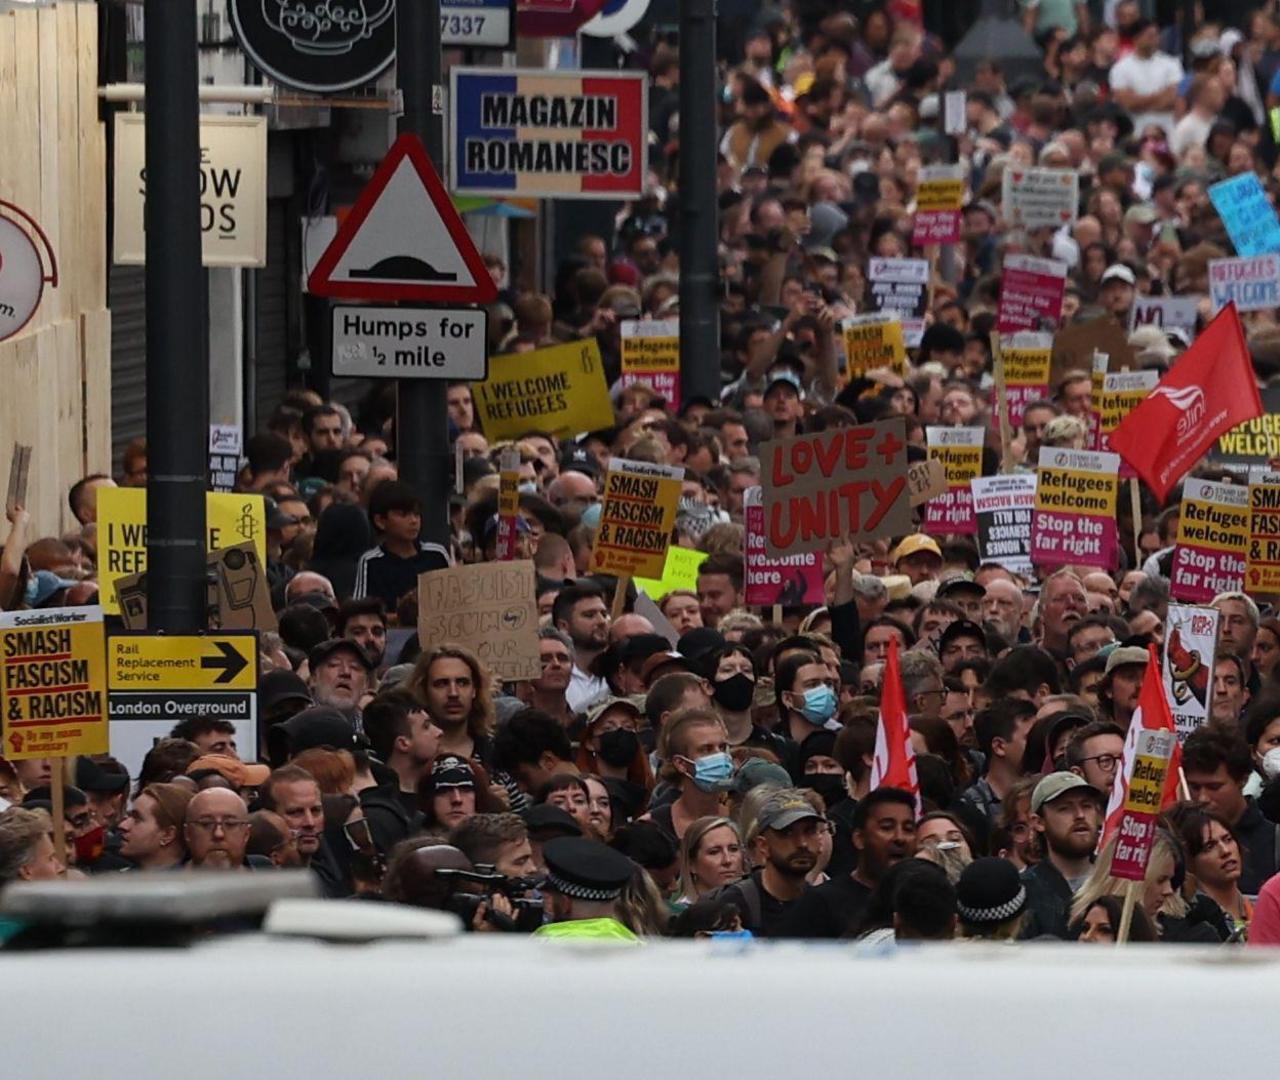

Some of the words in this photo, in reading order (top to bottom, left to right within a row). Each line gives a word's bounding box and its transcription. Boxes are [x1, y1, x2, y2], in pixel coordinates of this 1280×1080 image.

[483, 96, 616, 127] MAGAZIN
[467, 139, 630, 174] ROMANESC
[344, 315, 427, 340] Humps
[440, 318, 474, 338] for
[481, 385, 487, 399] I
[495, 372, 572, 400] WELCOME
[486, 394, 567, 420] REFUGEES
[772, 427, 875, 488] LOVE
[877, 432, 904, 465] +
[609, 476, 658, 497] SMASH
[1041, 471, 1113, 492] Refugees
[1040, 492, 1108, 509] welcome
[604, 502, 664, 524] FASCISM
[770, 476, 906, 550] UNITY
[1037, 514, 1073, 535] Stop
[1078, 517, 1103, 534] the
[1035, 533, 1059, 549] far
[1063, 535, 1100, 555] right
[1251, 541, 1261, 559] &
[748, 571, 781, 585] here
[5, 630, 71, 657] SMASH
[117, 644, 139, 654] Rail
[117, 657, 194, 668] Replacement
[5, 660, 88, 689] FASCISM
[117, 671, 160, 681] Service
[8, 697, 23, 720] &
[29, 691, 102, 719] RACISM
[109, 701, 161, 714] London
[165, 700, 247, 716] Overground
